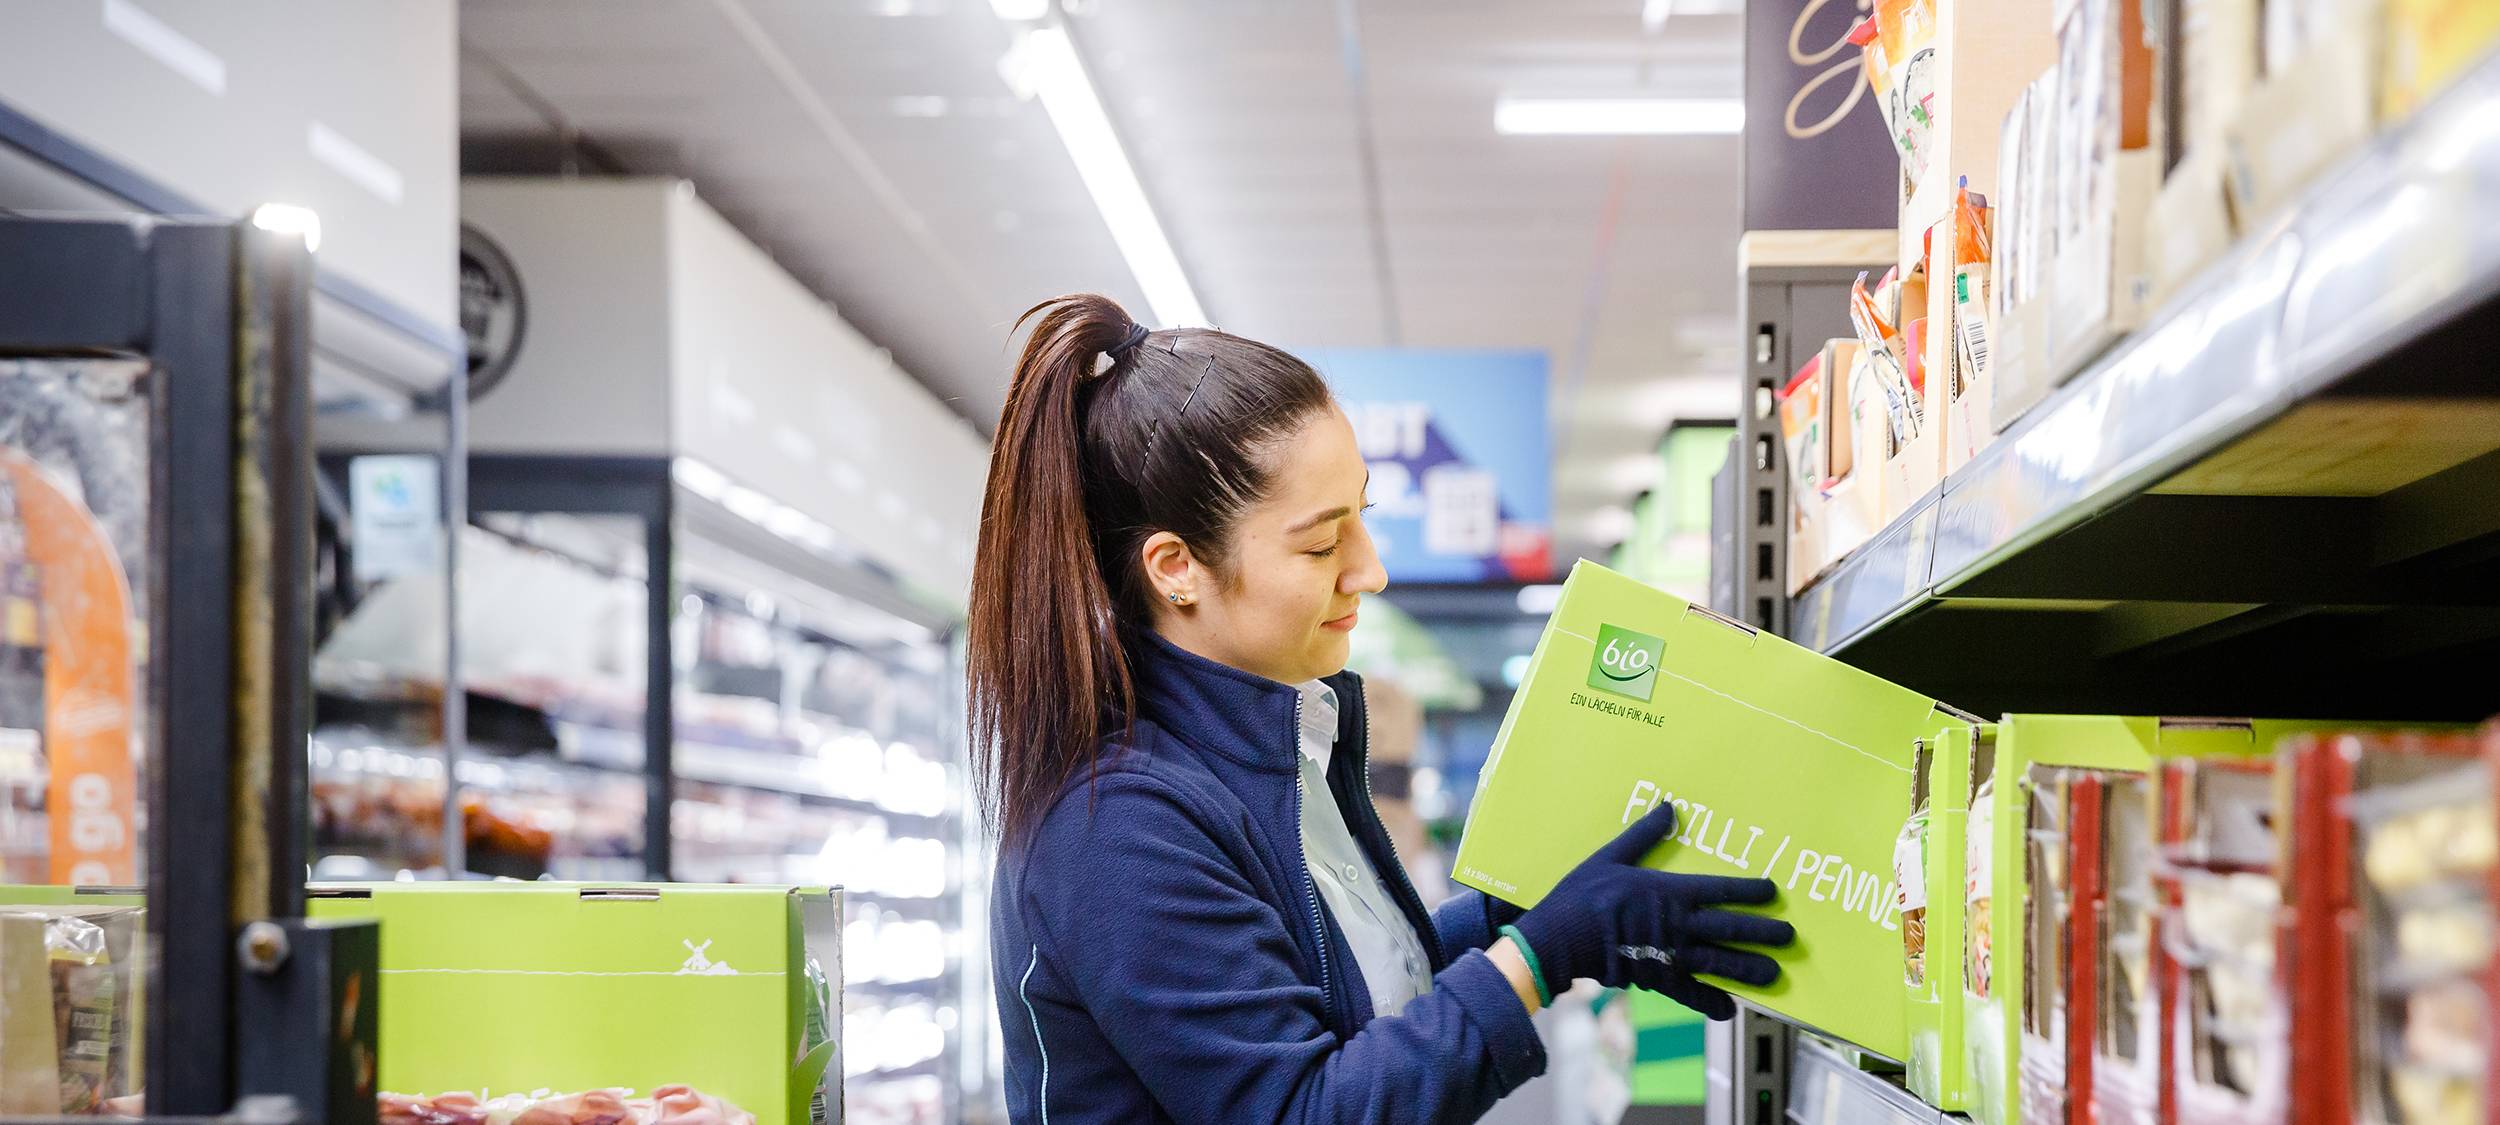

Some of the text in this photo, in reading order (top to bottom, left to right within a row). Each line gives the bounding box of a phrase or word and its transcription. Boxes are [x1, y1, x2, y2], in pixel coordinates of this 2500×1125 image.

[1602, 638, 1649, 671] bio
[1570, 692, 1587, 707] EIN
[1626, 706, 1642, 721] FÜR
[1643, 712, 1665, 728] ALLE
[1786, 848, 1901, 931] PENNE
